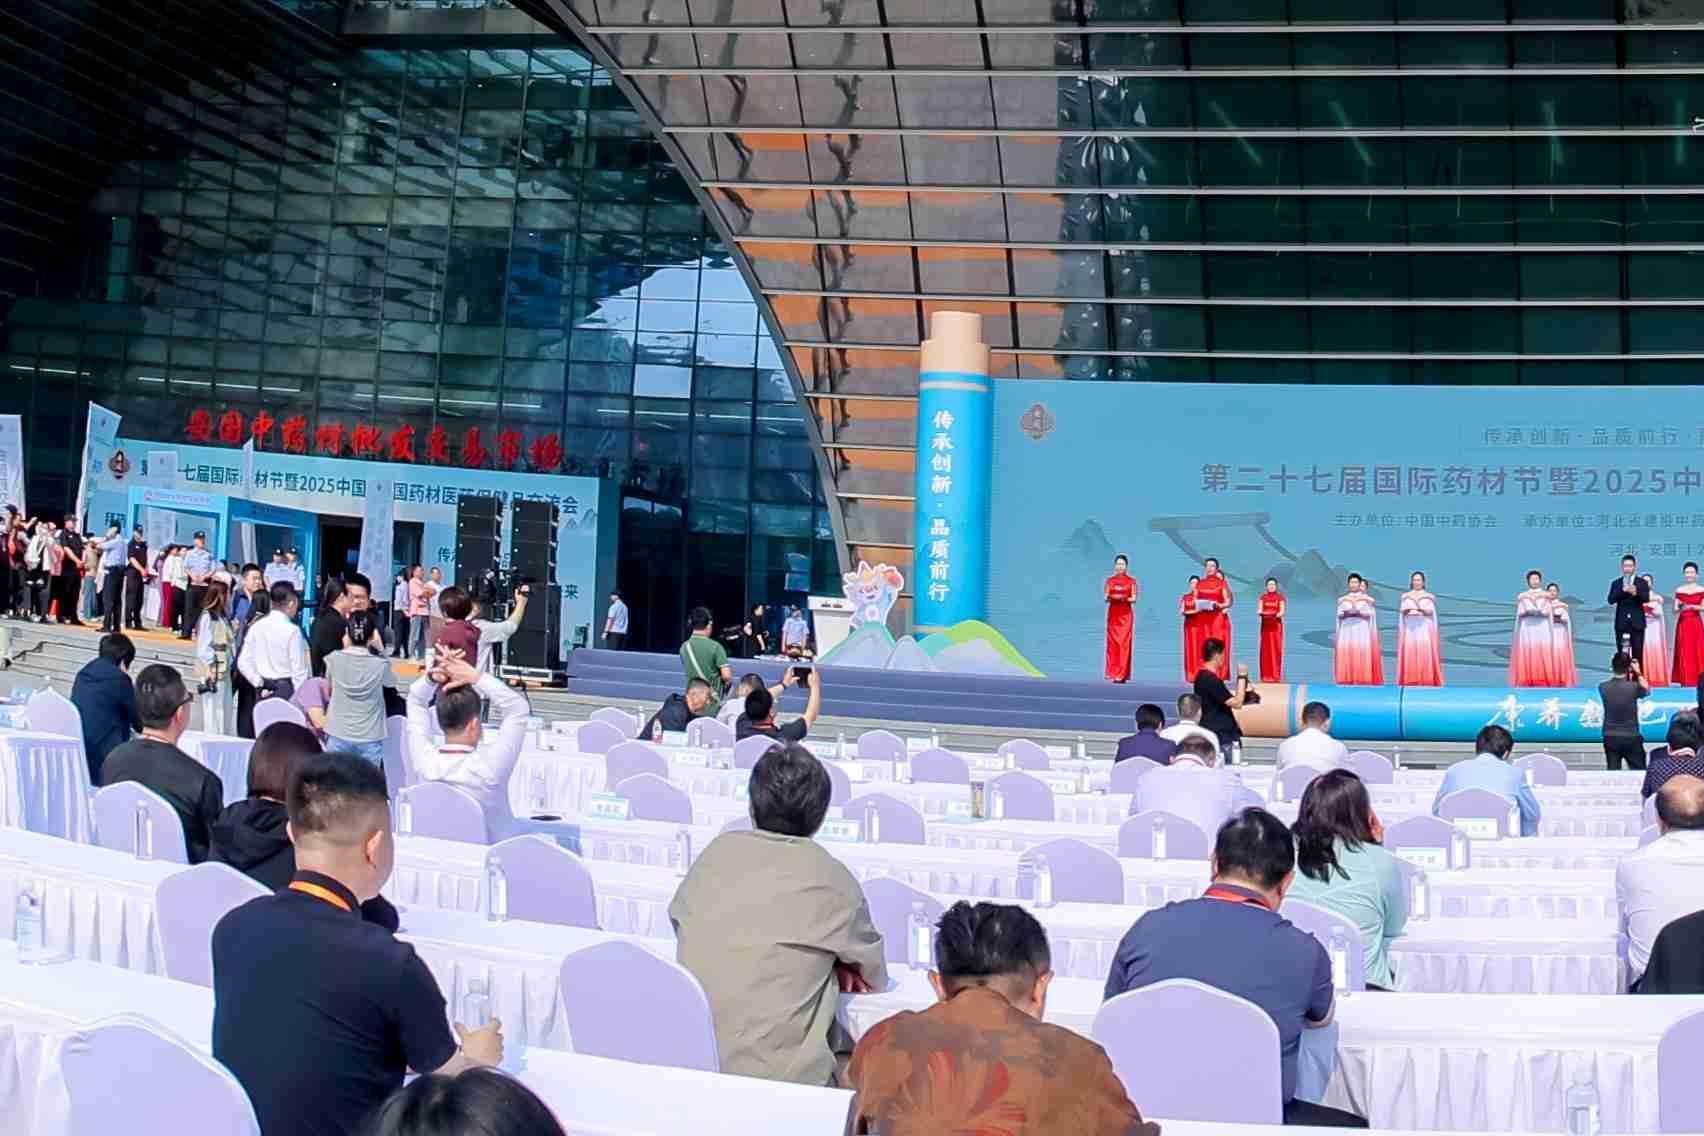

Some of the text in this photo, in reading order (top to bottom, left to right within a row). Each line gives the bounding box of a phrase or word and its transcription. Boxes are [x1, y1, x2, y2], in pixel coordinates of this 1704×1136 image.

[927, 410, 956, 603] 传承创新·品质前行
